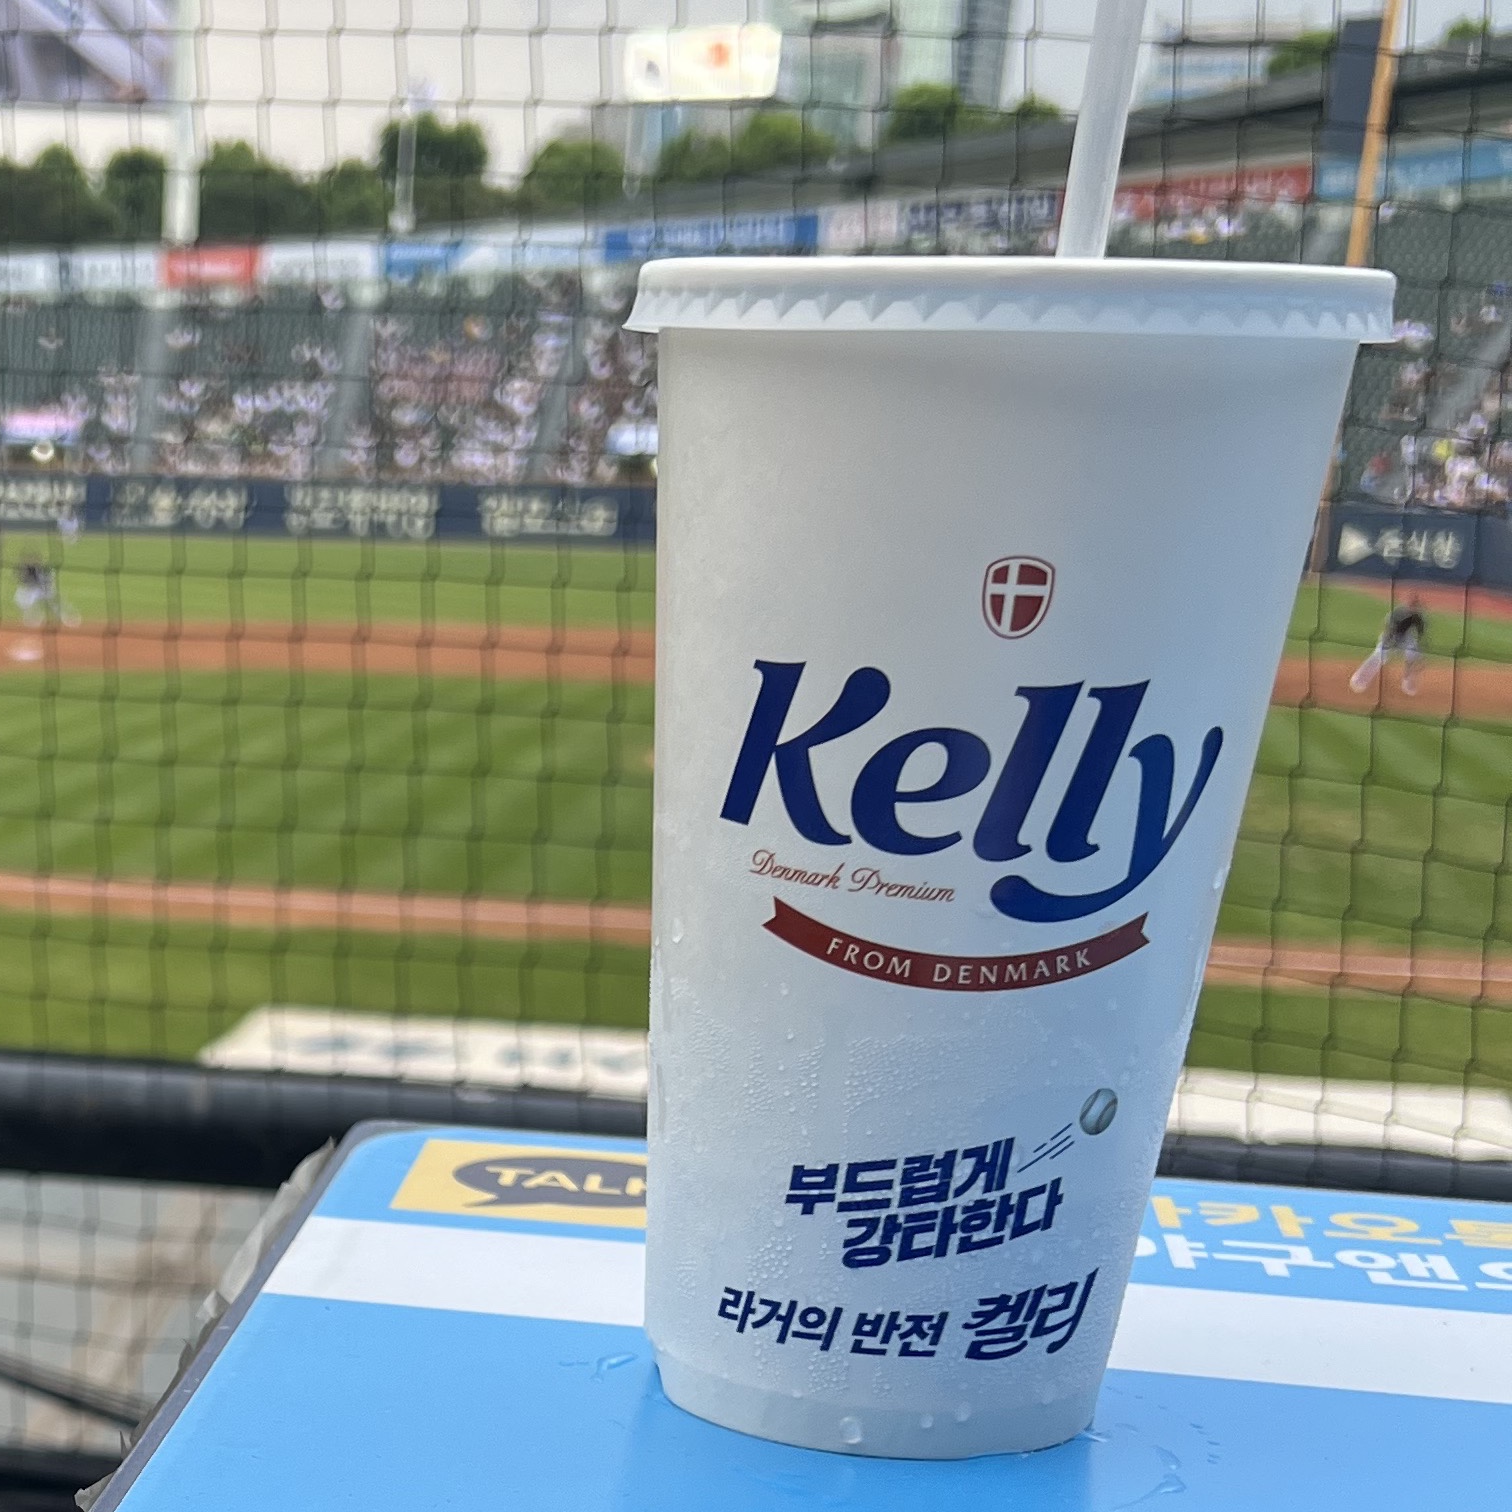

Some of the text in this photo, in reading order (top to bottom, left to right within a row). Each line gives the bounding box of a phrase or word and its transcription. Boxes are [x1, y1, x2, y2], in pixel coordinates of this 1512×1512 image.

[720, 659, 1224, 923] Kelly
[749, 849, 956, 903] Denmark Premium
[826, 936, 1091, 985] FROM DENMARK
[785, 1136, 1016, 1216] 부드럽게
[841, 1176, 1065, 1269] 강타한다
[717, 1266, 1100, 1362] 라거의 반전 켈리
